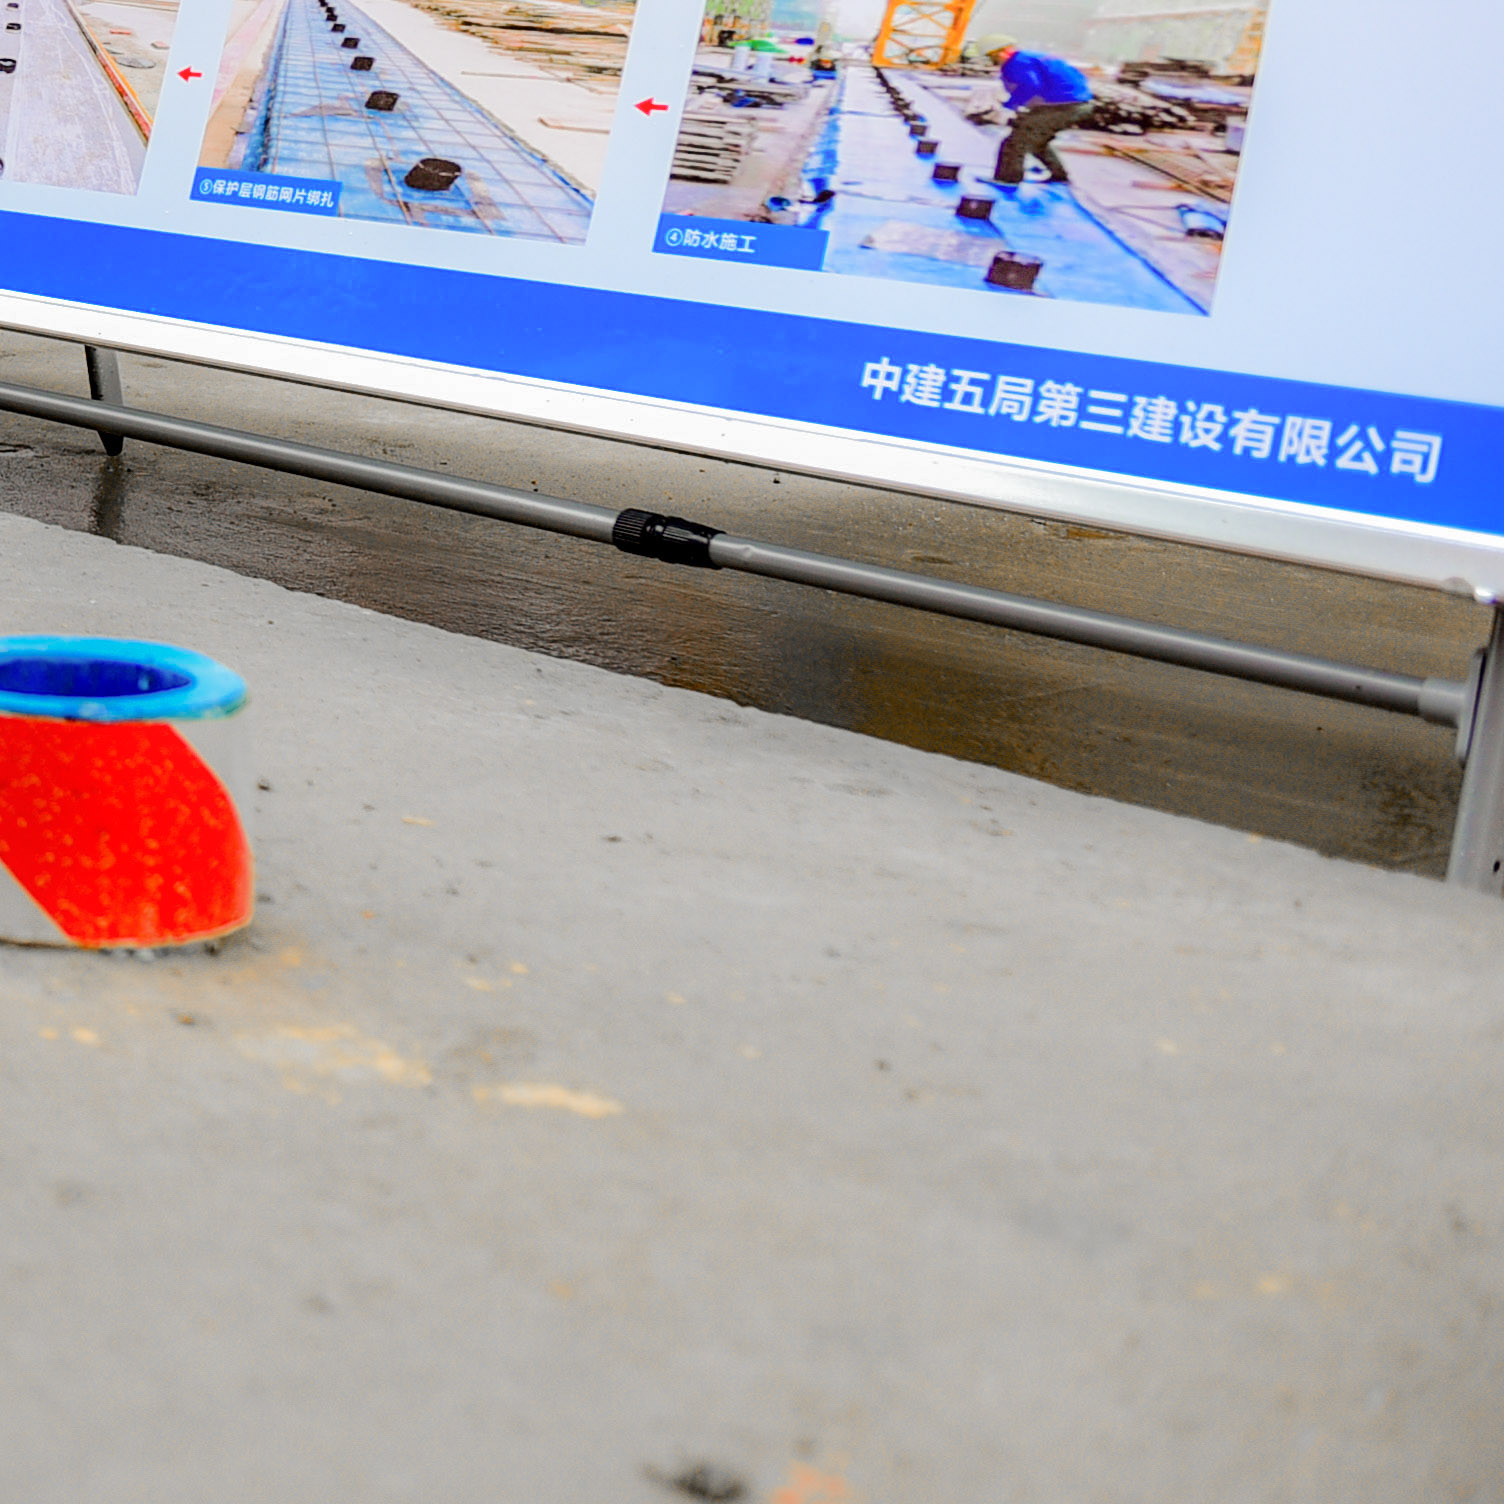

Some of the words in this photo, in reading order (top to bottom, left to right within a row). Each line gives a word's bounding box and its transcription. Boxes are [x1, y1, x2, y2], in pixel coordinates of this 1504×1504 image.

[200, 178, 334, 208] ⑤保护层钢筋网片绑扎
[665, 227, 756, 254] ④防水施工
[860, 354, 1443, 484] 中建五局第三建设有限公司
